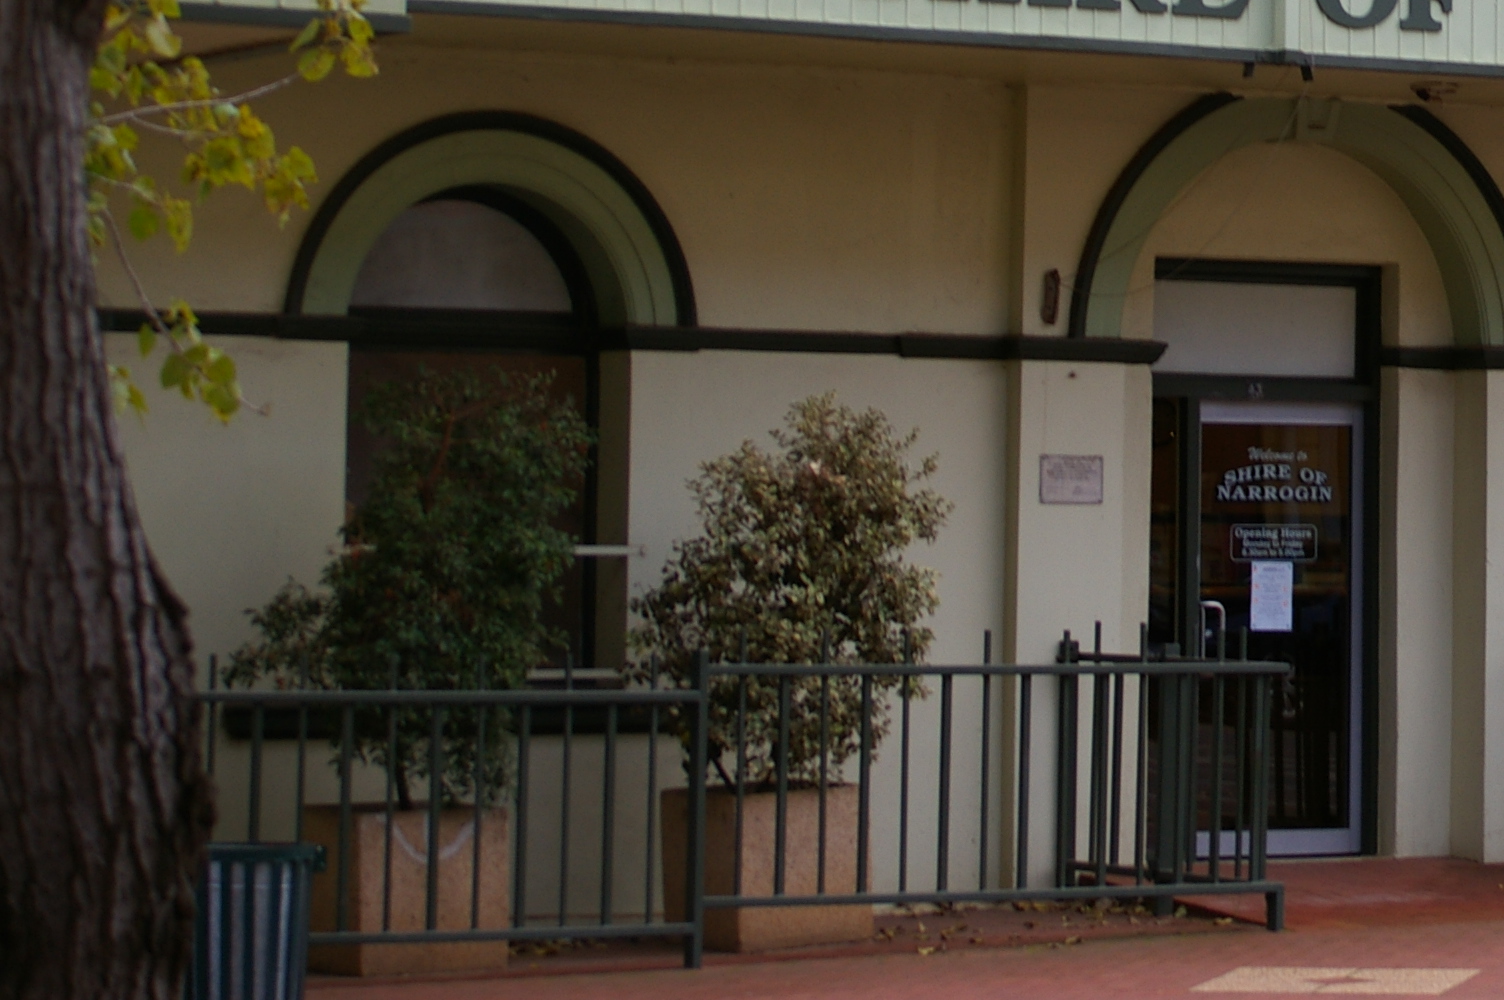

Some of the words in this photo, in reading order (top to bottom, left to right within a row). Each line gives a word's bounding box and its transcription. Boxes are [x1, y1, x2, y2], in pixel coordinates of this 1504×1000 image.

[1223, 463, 1292, 486] SHIRE
[1299, 467, 1328, 486] OF
[1216, 484, 1333, 501] NARROGIN
[1234, 527, 1278, 540] Opening
[1281, 527, 1312, 538] Hours
